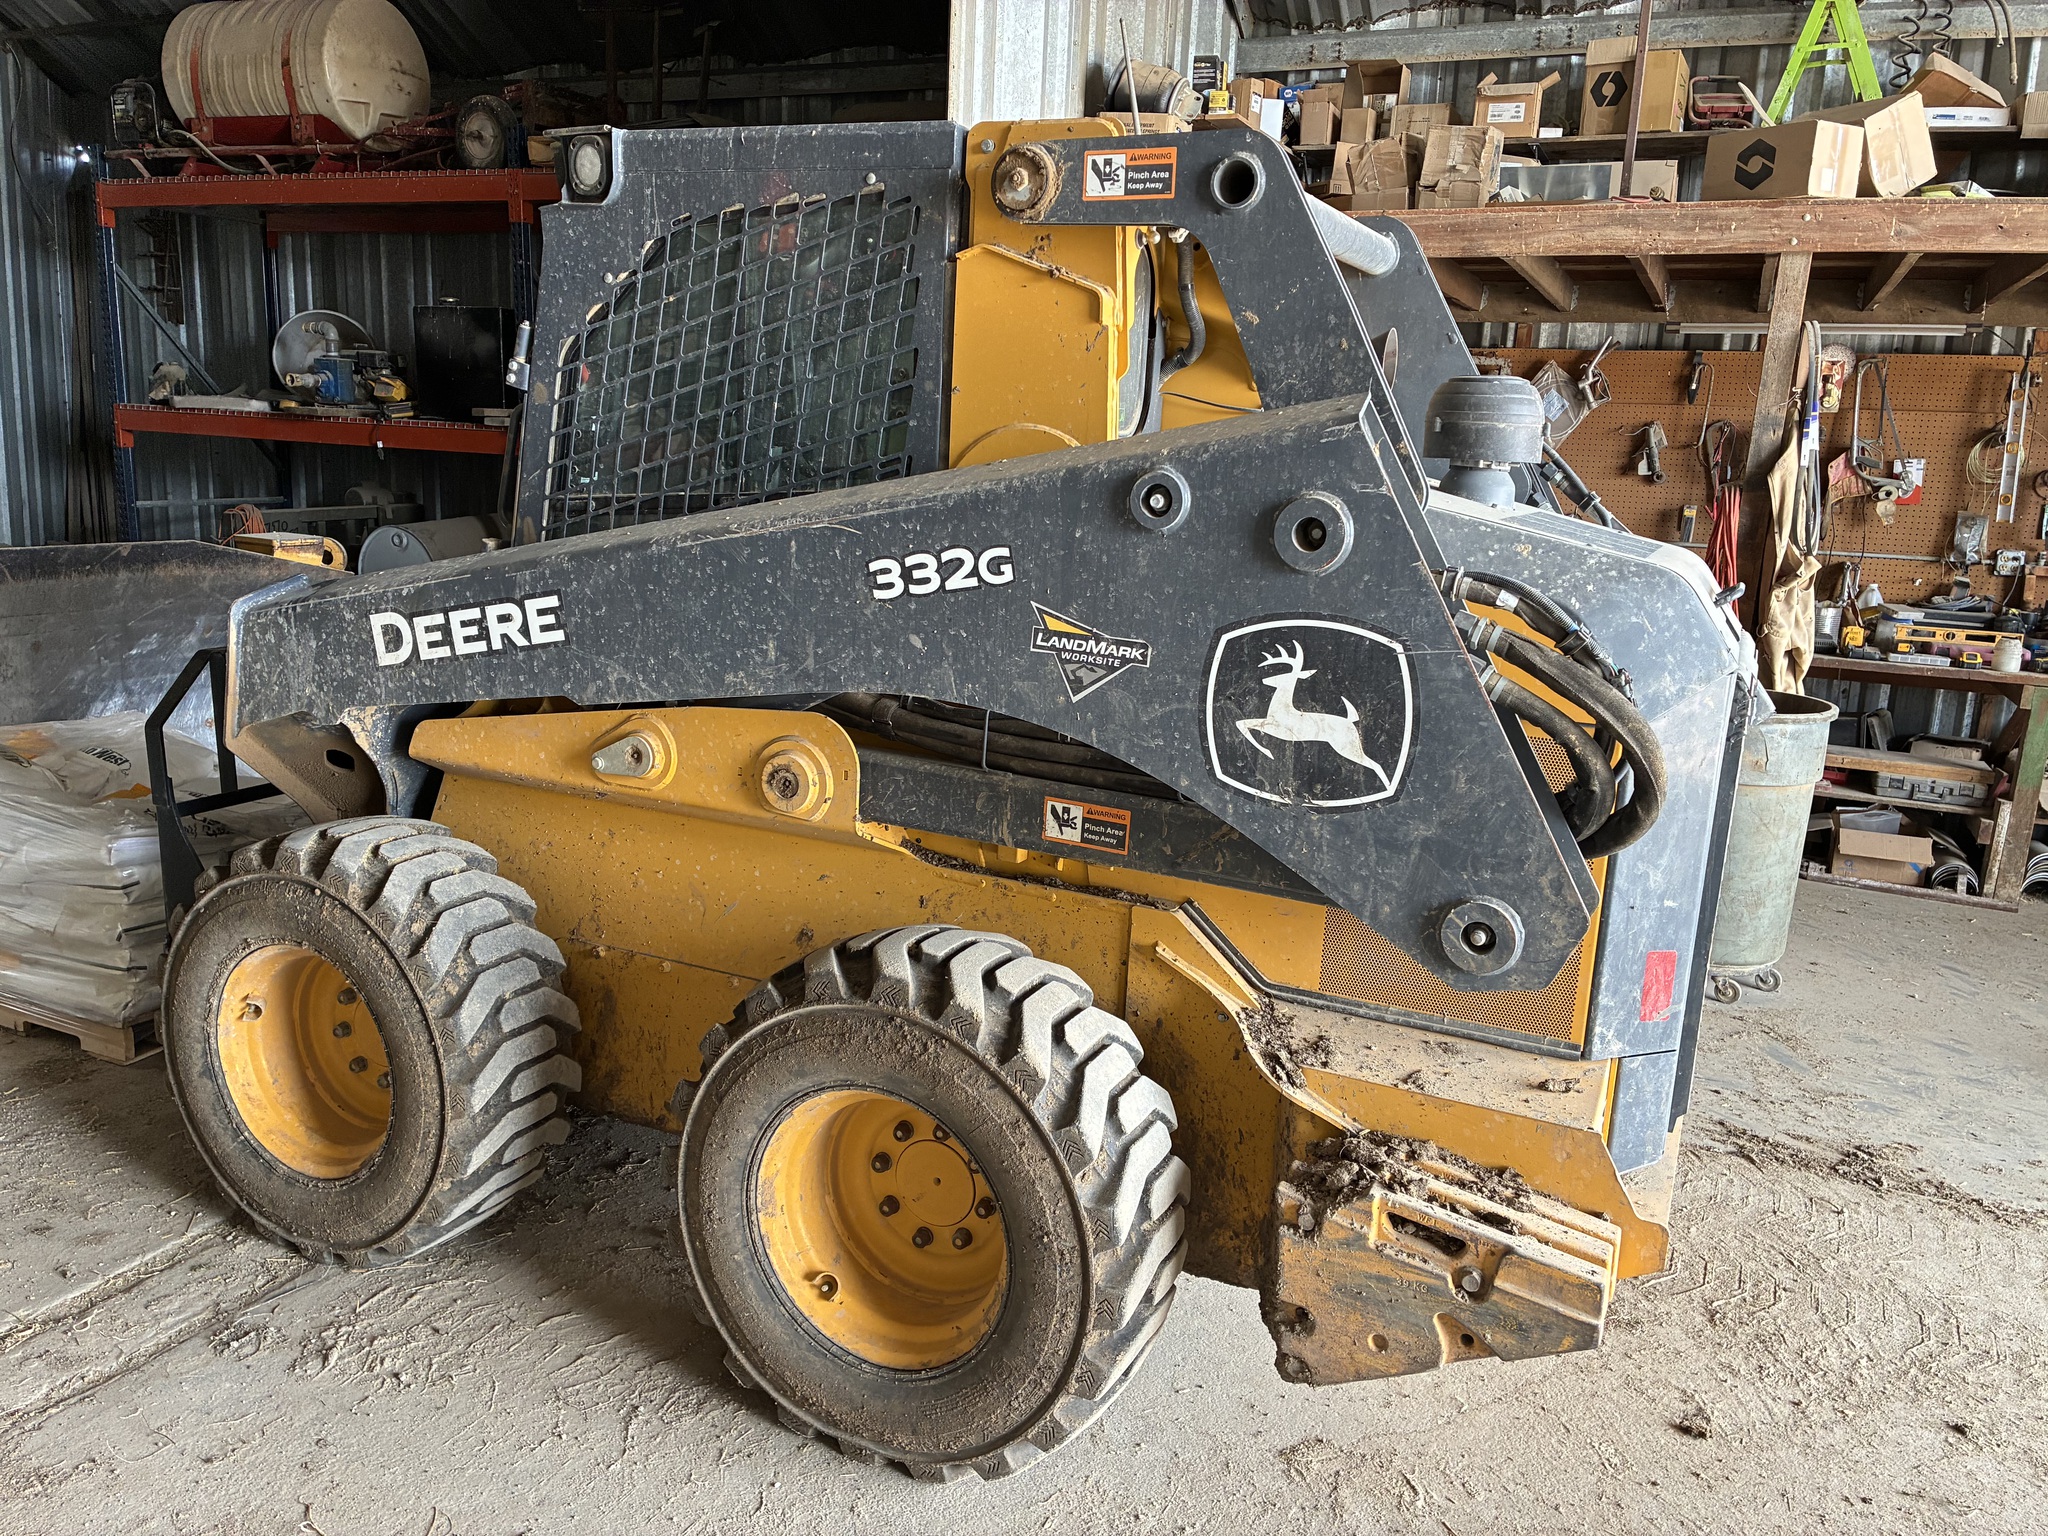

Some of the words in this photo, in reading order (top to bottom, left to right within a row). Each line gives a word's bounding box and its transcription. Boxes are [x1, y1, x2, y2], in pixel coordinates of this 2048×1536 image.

[1137, 152, 1172, 161] WARNING
[1127, 171, 1150, 180] Pinch
[1151, 170, 1170, 179] Area
[1127, 182, 1145, 190] Keep
[1145, 181, 1163, 190] Away
[867, 546, 1015, 600] 332G
[369, 595, 566, 667] DEERE
[1035, 632, 1146, 661] LANDMARK
[1061, 651, 1122, 667] WORKSITE
[1093, 810, 1126, 821] WARNING
[1084, 823, 1105, 833] Pinch
[1106, 827, 1125, 837] Area
[1083, 832, 1100, 842] Keep
[1100, 836, 1118, 845] Away
[1413, 1280, 1429, 1293] KG
